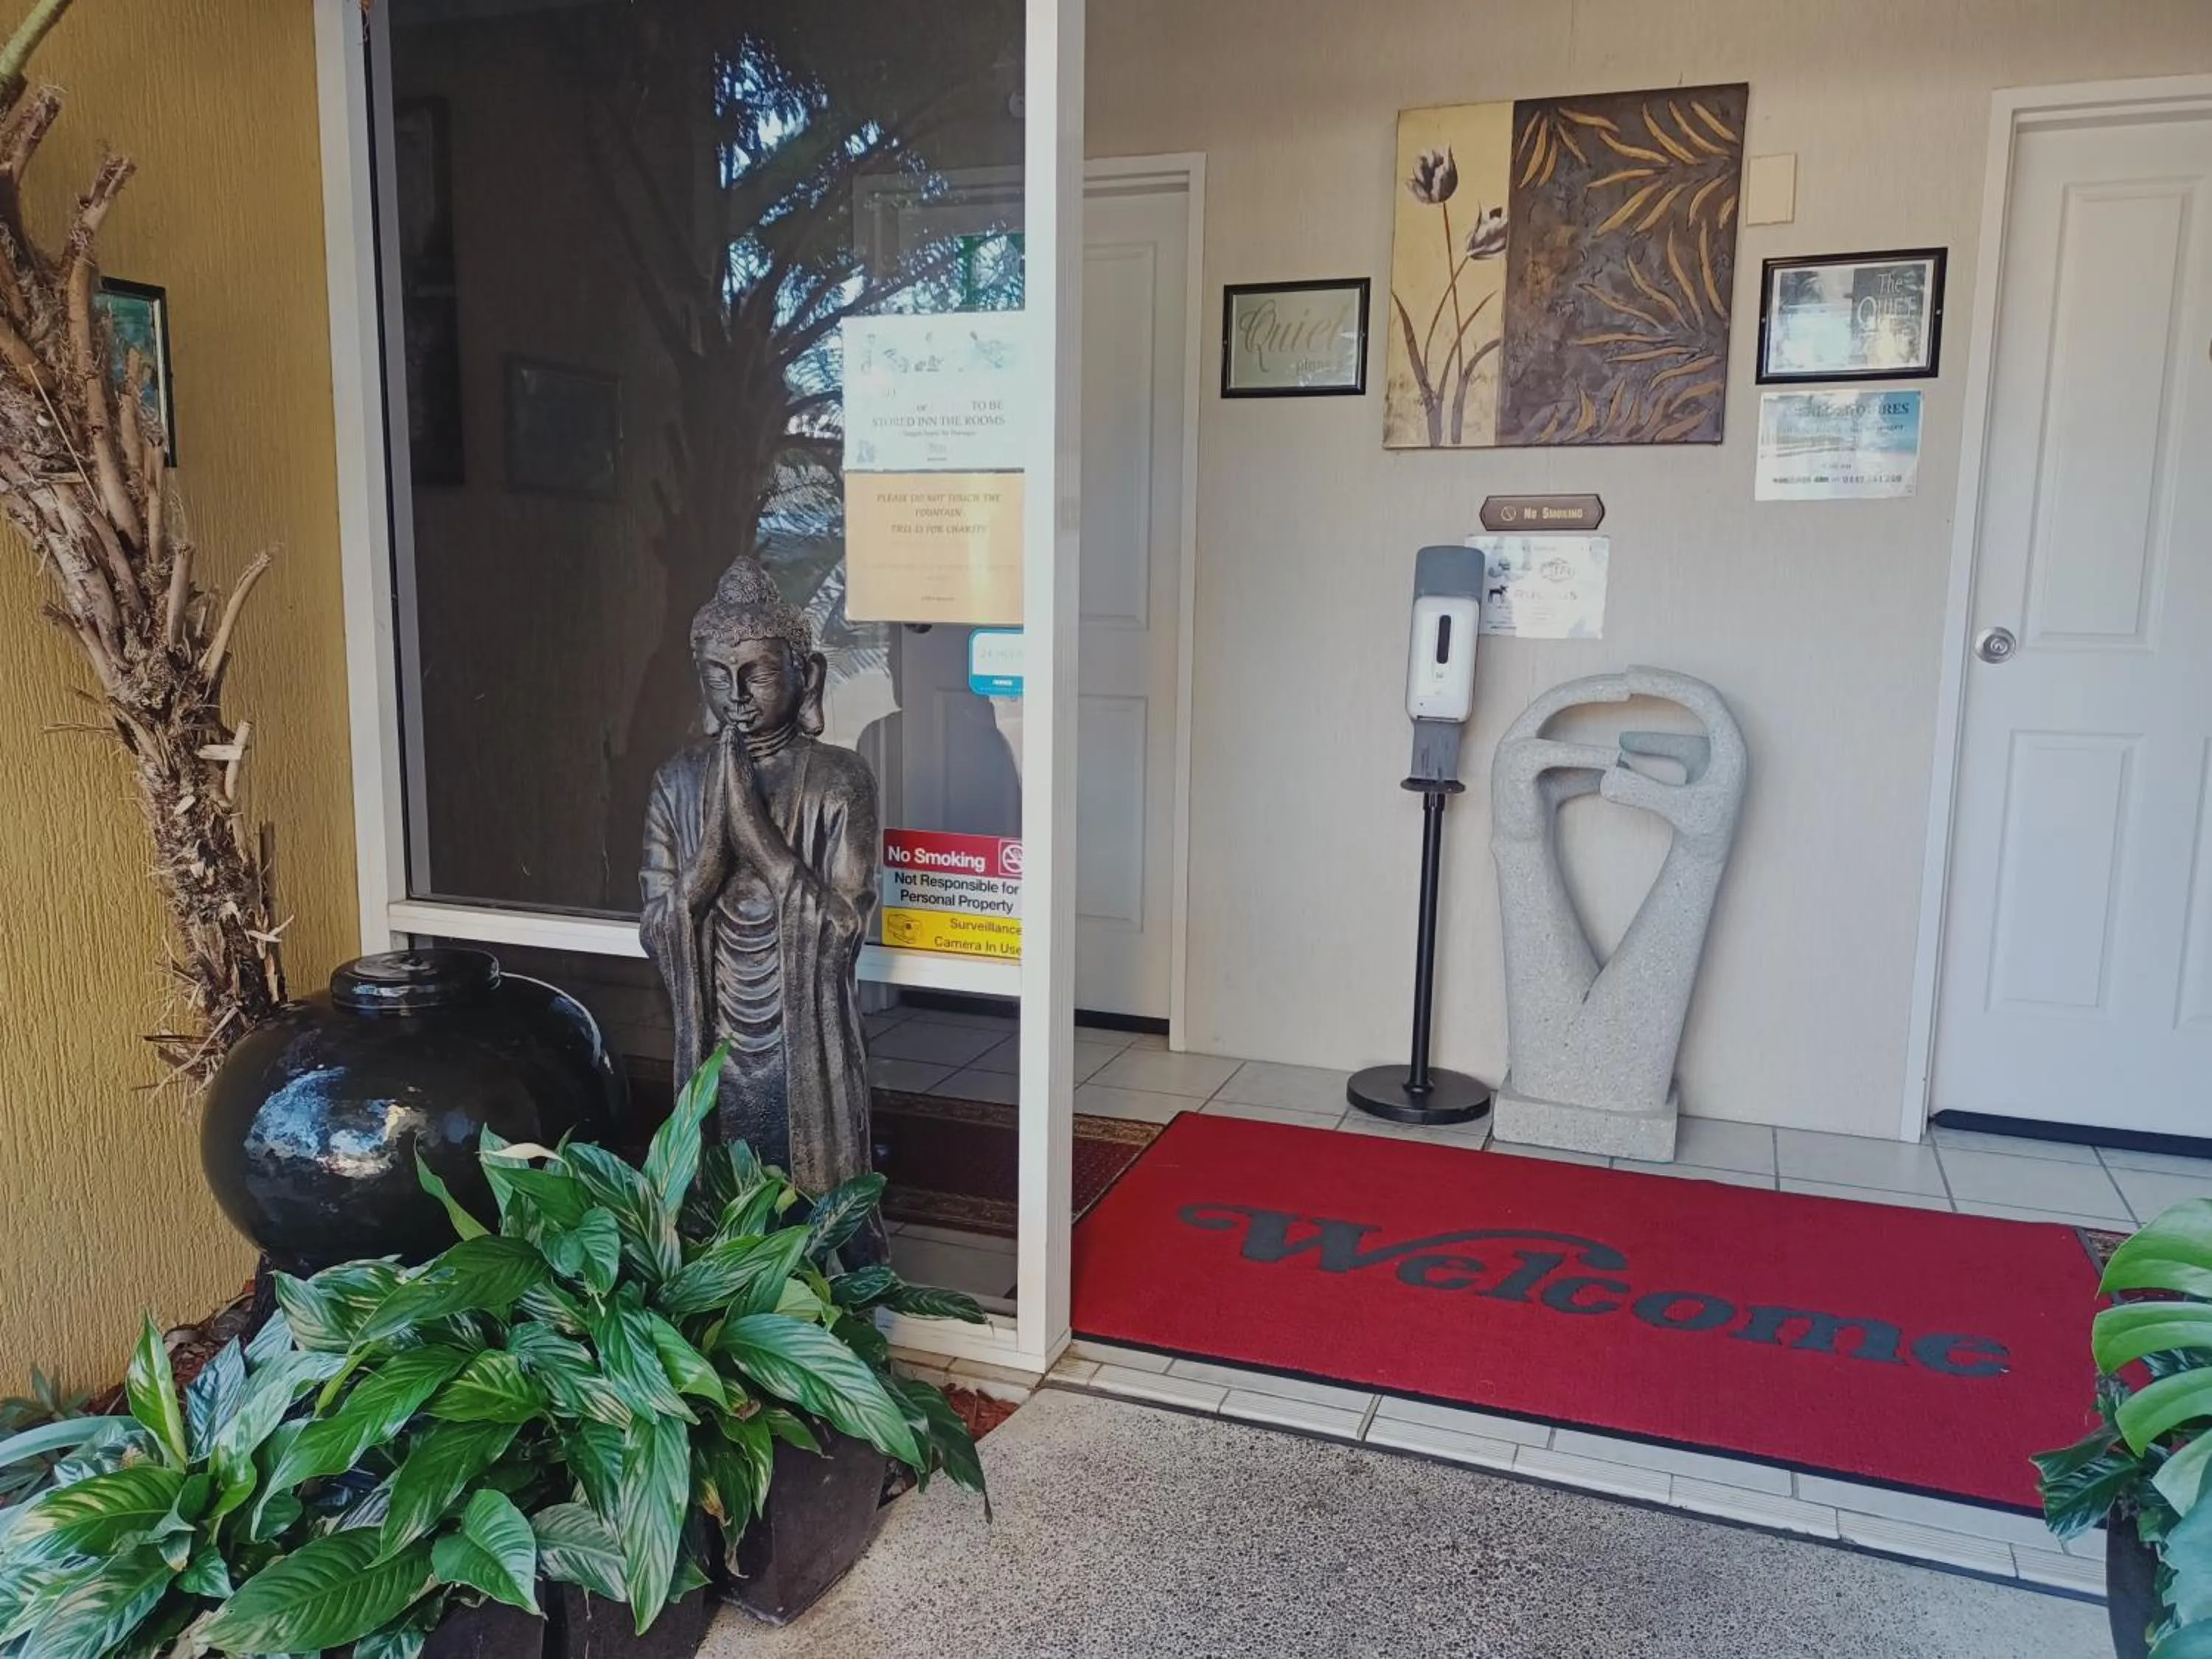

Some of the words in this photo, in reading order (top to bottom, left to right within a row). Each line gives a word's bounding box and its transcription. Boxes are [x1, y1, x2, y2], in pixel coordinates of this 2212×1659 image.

[1877, 271, 1903, 294] The
[964, 414, 1006, 426] ROOMS
[888, 846, 911, 862] No
[914, 848, 986, 872] Smoking
[894, 871, 917, 886] Not
[919, 874, 999, 893] Responsible
[1001, 881, 1019, 895] for
[900, 888, 956, 906] Personal
[958, 894, 1014, 914] Property
[950, 918, 1022, 936] Surveillance
[934, 936, 982, 951] Camera
[985, 941, 996, 952] In
[1000, 942, 1022, 954] Use
[1178, 1203, 2011, 1378] Welcome
